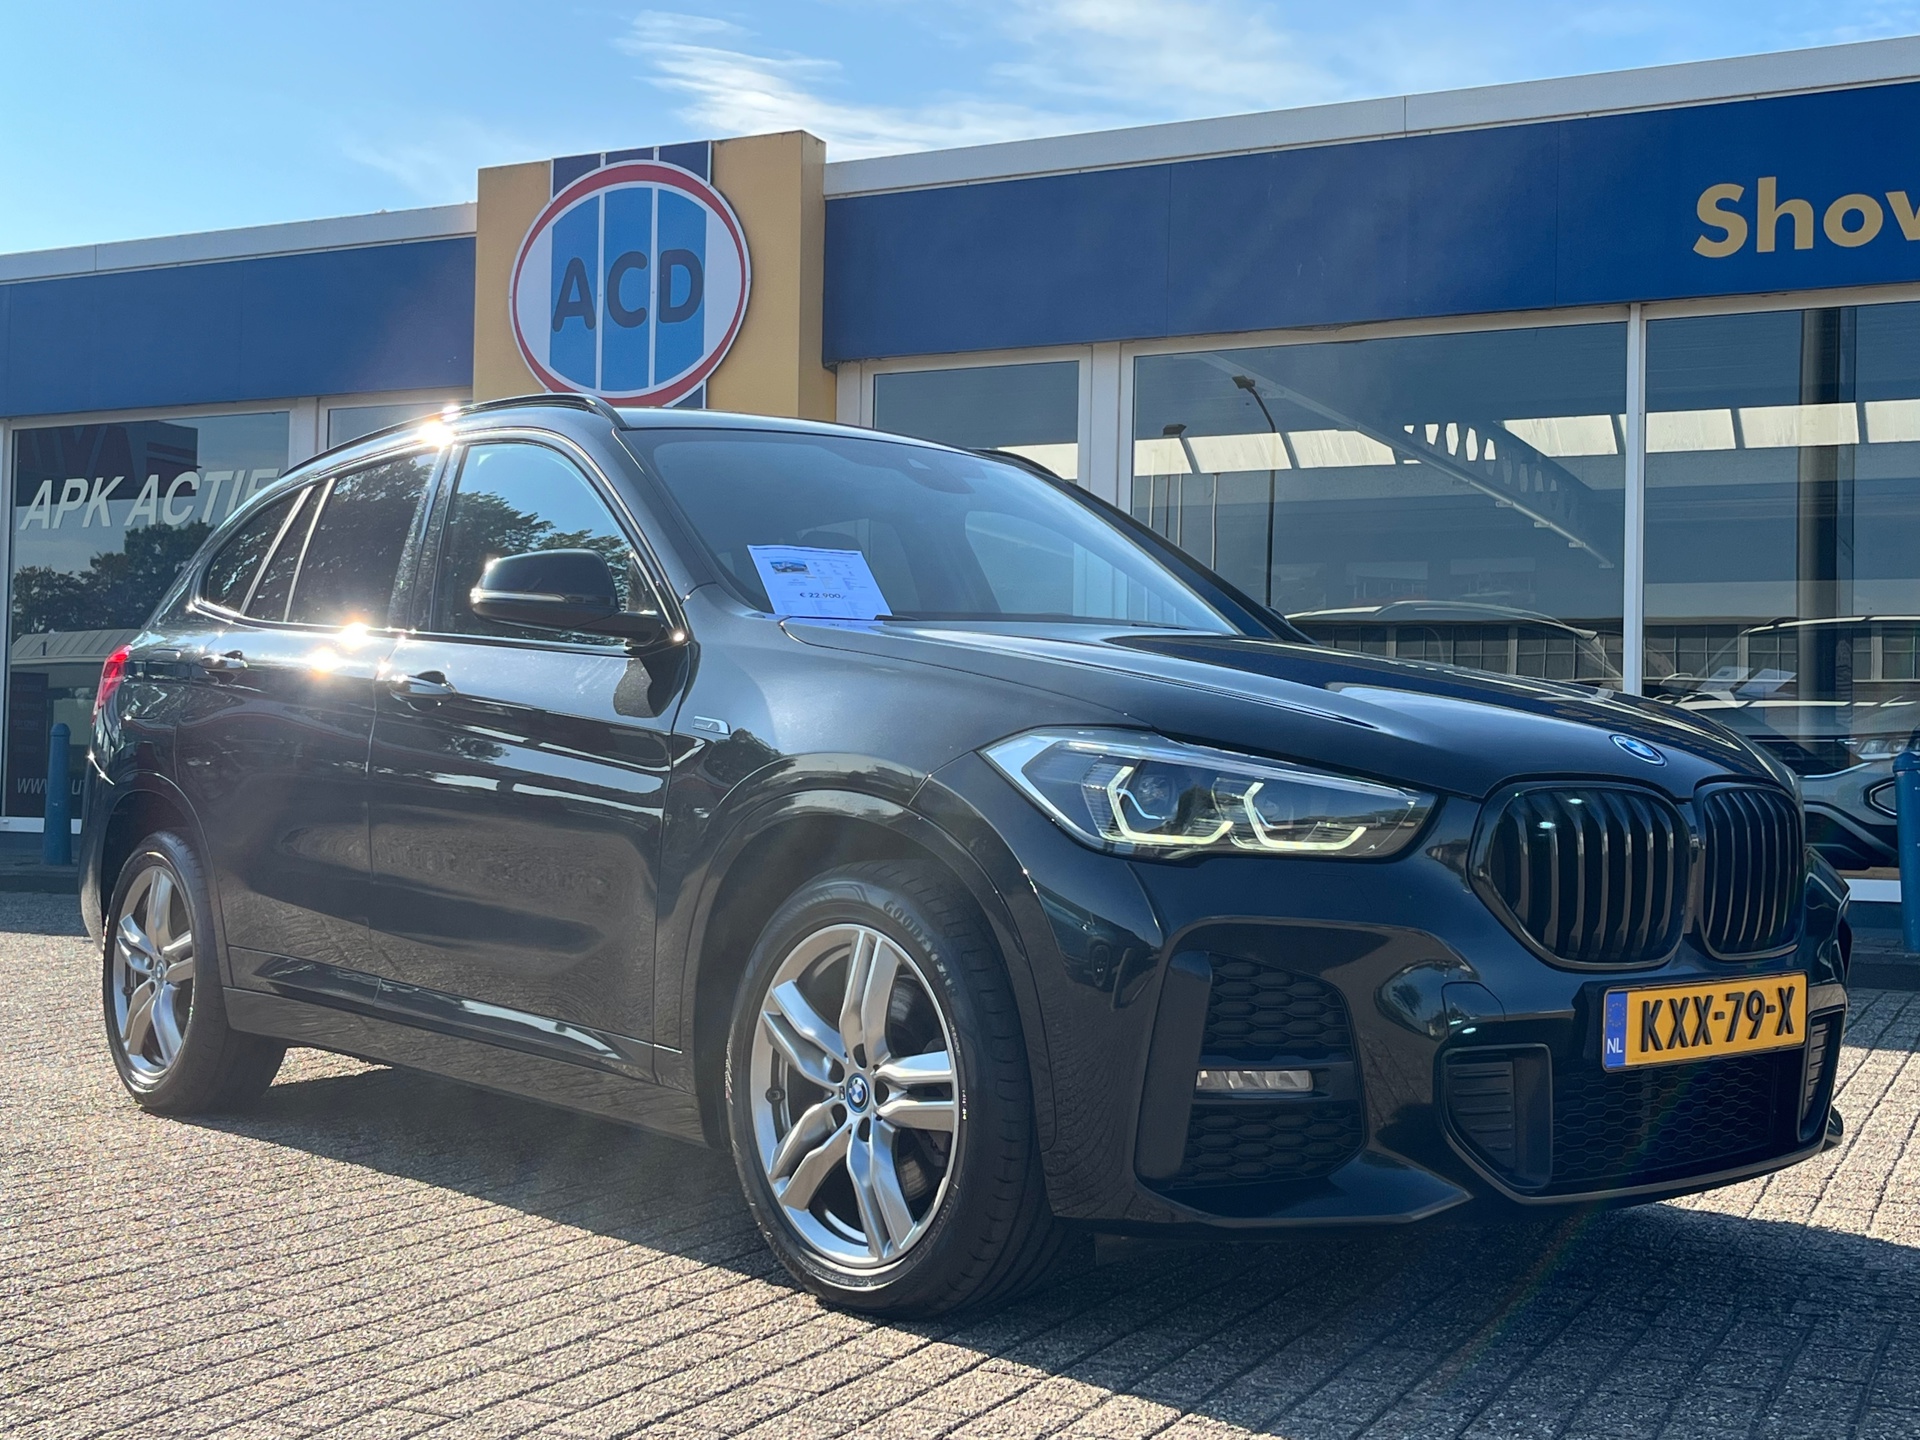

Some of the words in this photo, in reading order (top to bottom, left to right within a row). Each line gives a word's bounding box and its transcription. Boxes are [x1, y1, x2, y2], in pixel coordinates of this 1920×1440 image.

[552, 249, 704, 332] ACD
[19, 476, 125, 530] APK
[1607, 1038, 1623, 1054] NL
[1641, 986, 1795, 1053] KXX-79-X
